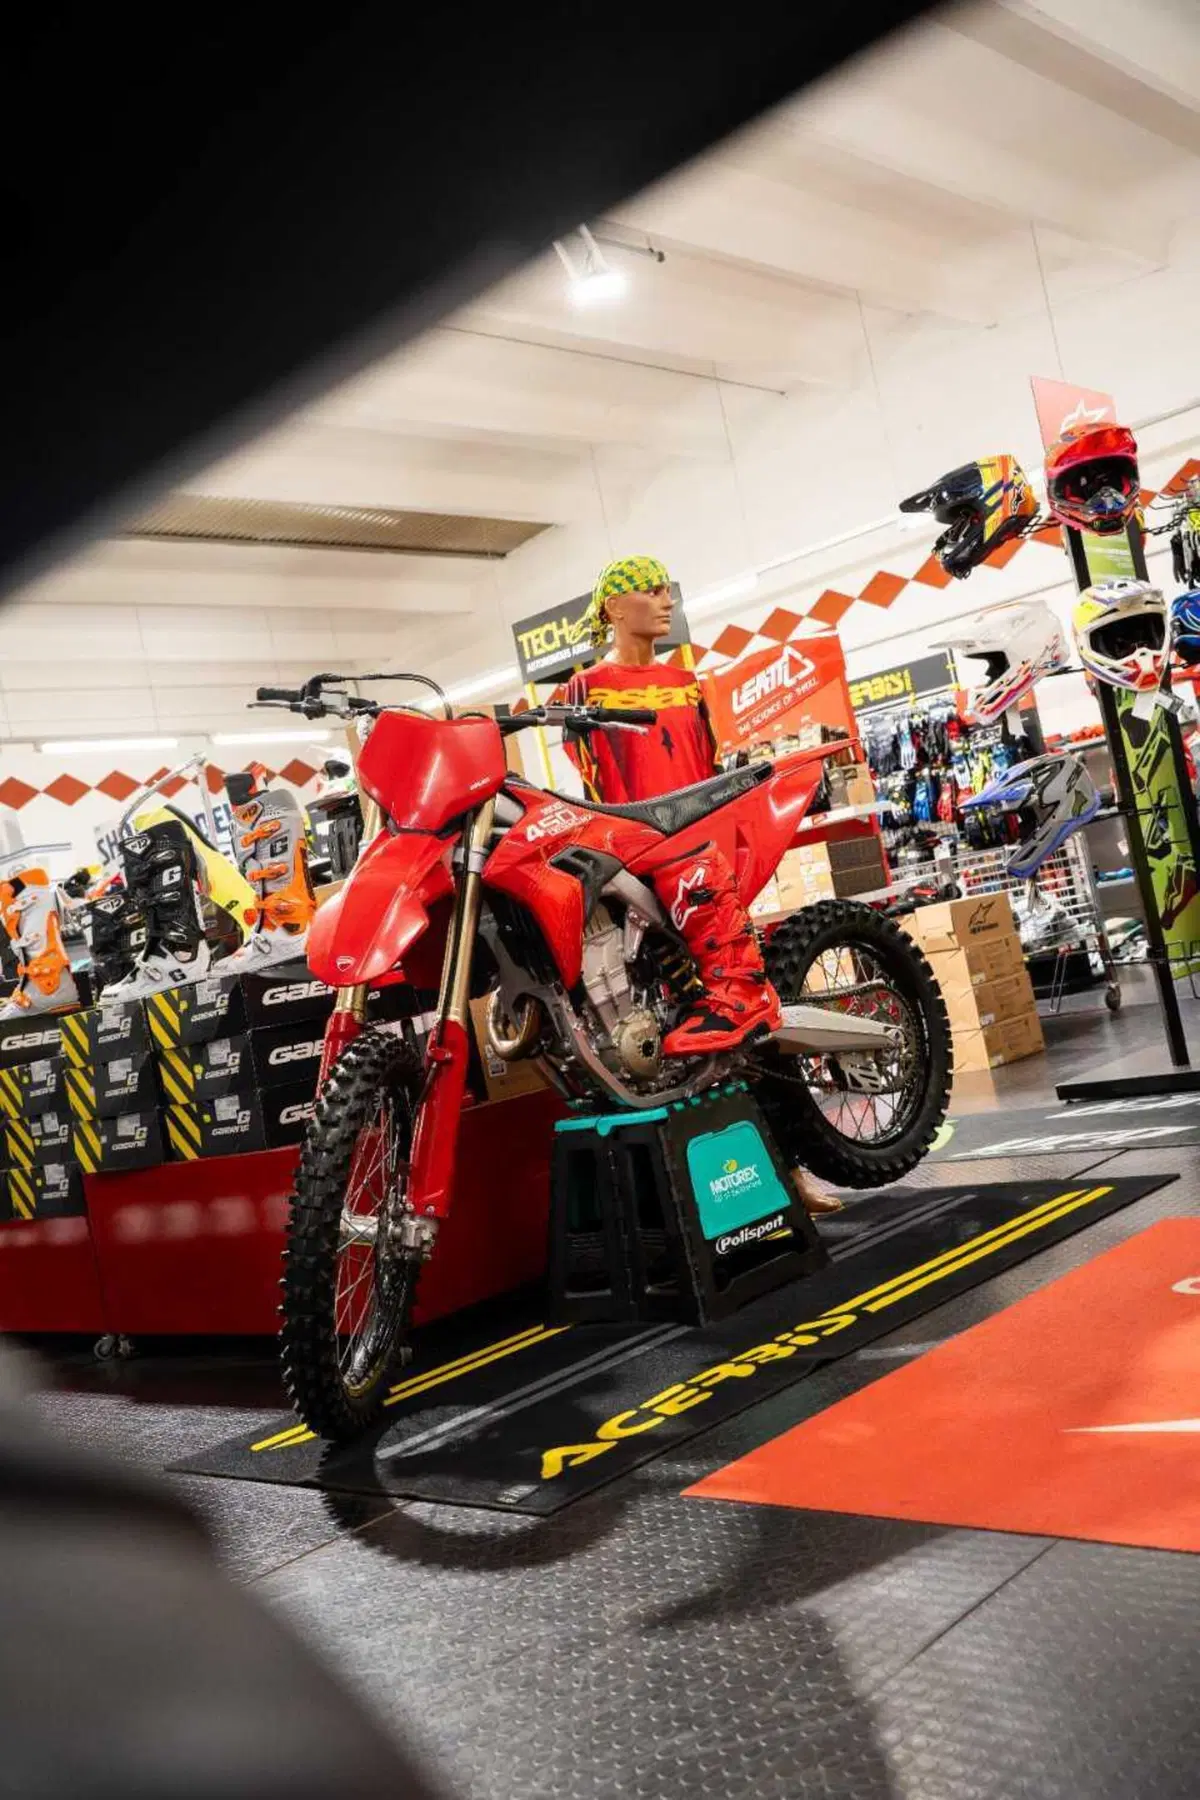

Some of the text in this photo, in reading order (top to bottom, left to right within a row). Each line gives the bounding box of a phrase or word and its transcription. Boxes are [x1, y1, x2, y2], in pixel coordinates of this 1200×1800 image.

[526, 808, 577, 842] 450
[709, 1164, 760, 1195] MOTOREX
[718, 1215, 784, 1253] Polisport
